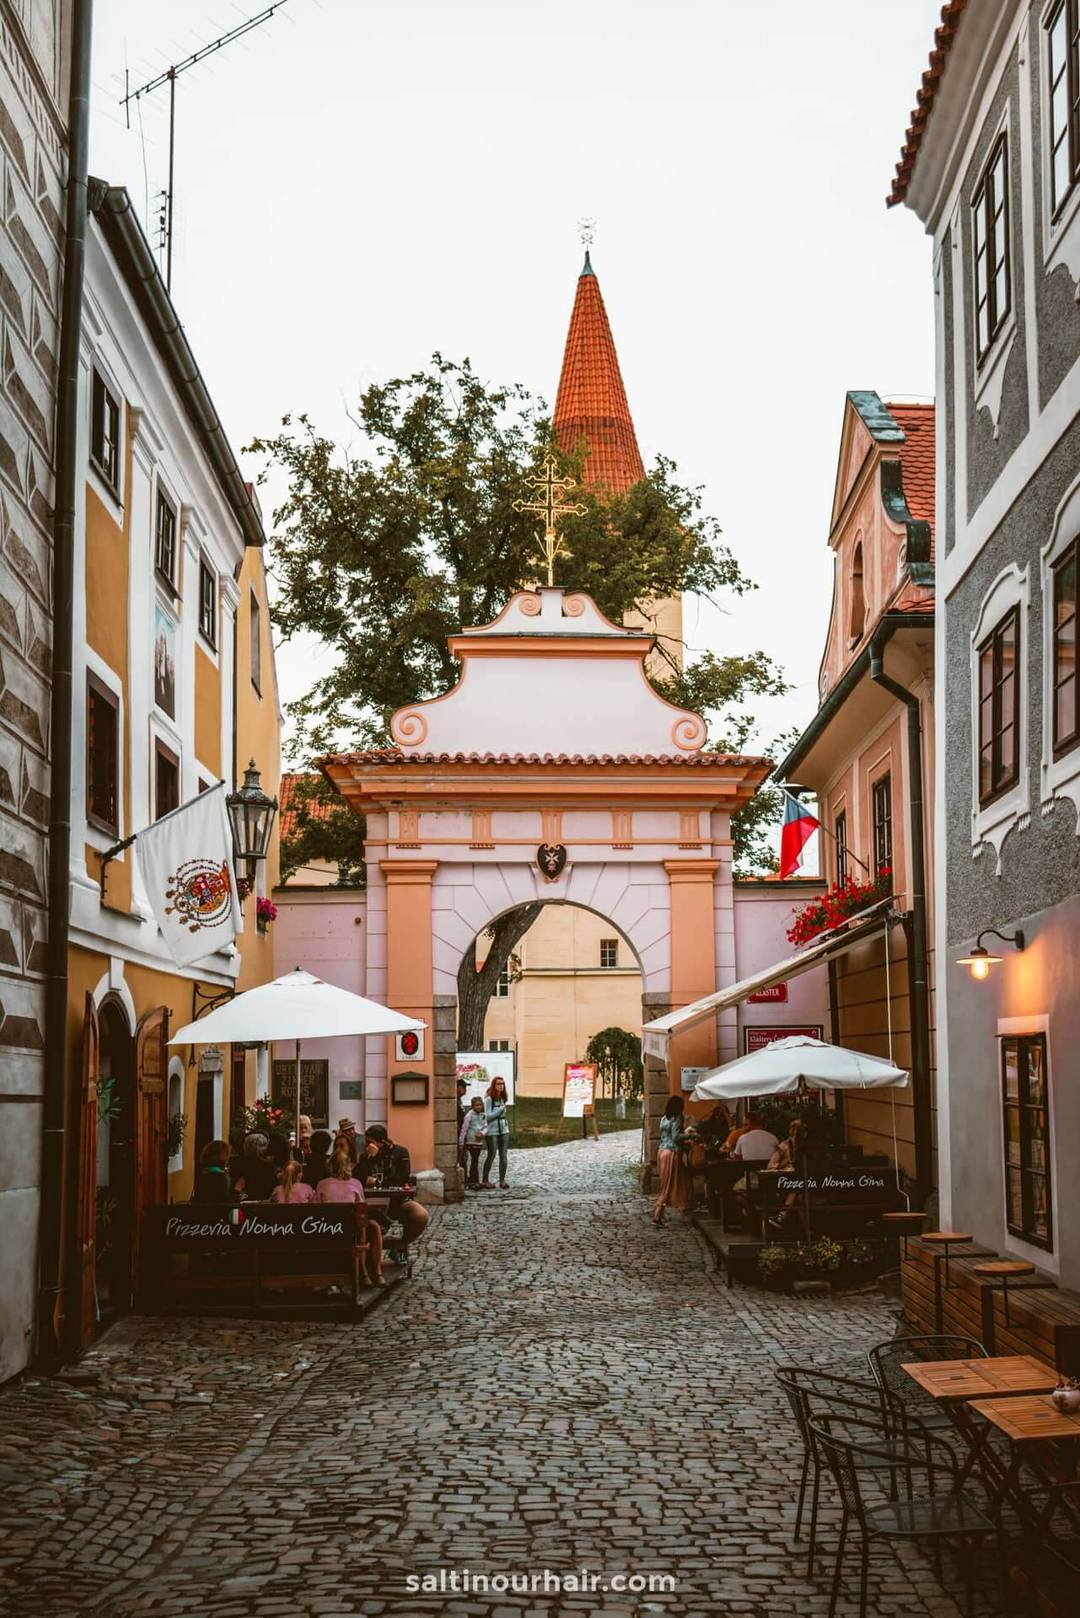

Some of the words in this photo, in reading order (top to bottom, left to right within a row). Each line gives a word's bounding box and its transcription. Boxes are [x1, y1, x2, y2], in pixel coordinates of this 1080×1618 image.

[280, 1075, 315, 1086] ZIMER
[777, 1176, 818, 1189] Pizzeia
[821, 1175, 856, 1188] Nonna
[858, 1175, 885, 1188] Gina
[166, 1217, 232, 1236] Pizzeria
[239, 1216, 295, 1236] Nonna
[301, 1216, 344, 1236] Gina
